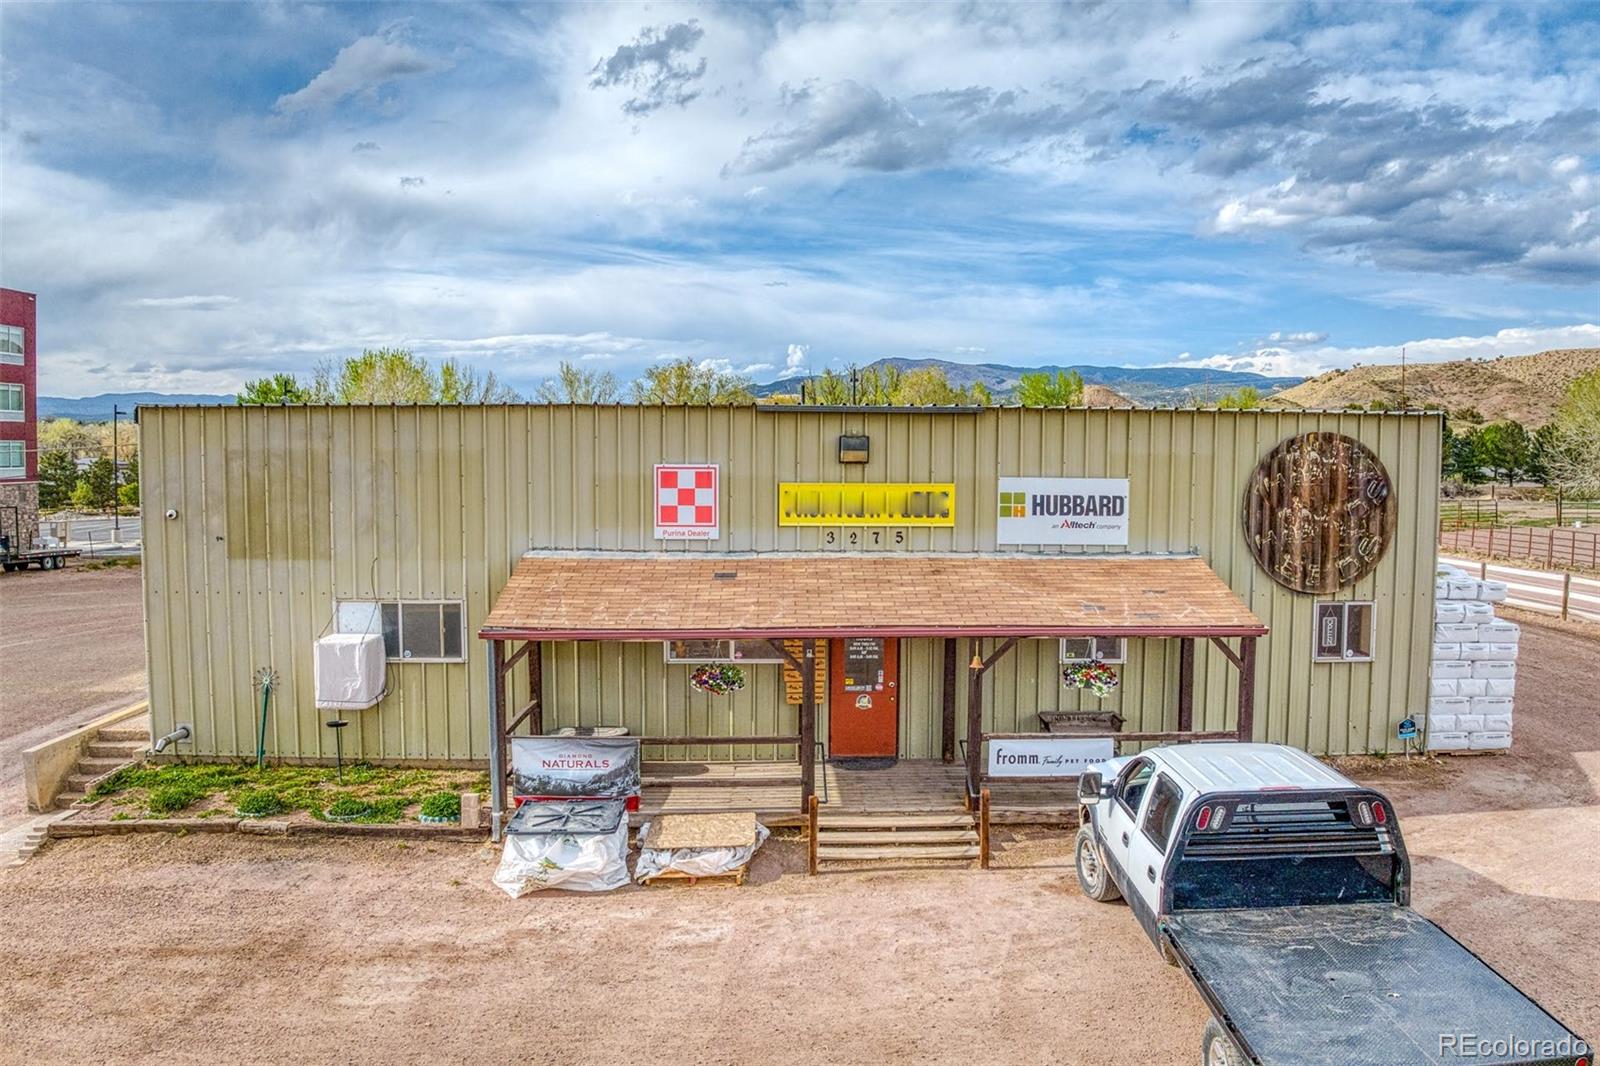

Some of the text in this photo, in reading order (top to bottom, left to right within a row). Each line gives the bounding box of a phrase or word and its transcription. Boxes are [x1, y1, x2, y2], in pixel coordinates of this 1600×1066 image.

[1031, 494, 1125, 517] HUBBARD
[1060, 519, 1096, 529] Alltech
[662, 529, 710, 537] Purina Dealer
[996, 748, 1039, 765] fromm
[1042, 755, 1063, 767] Family
[542, 759, 610, 769] NATURALS
